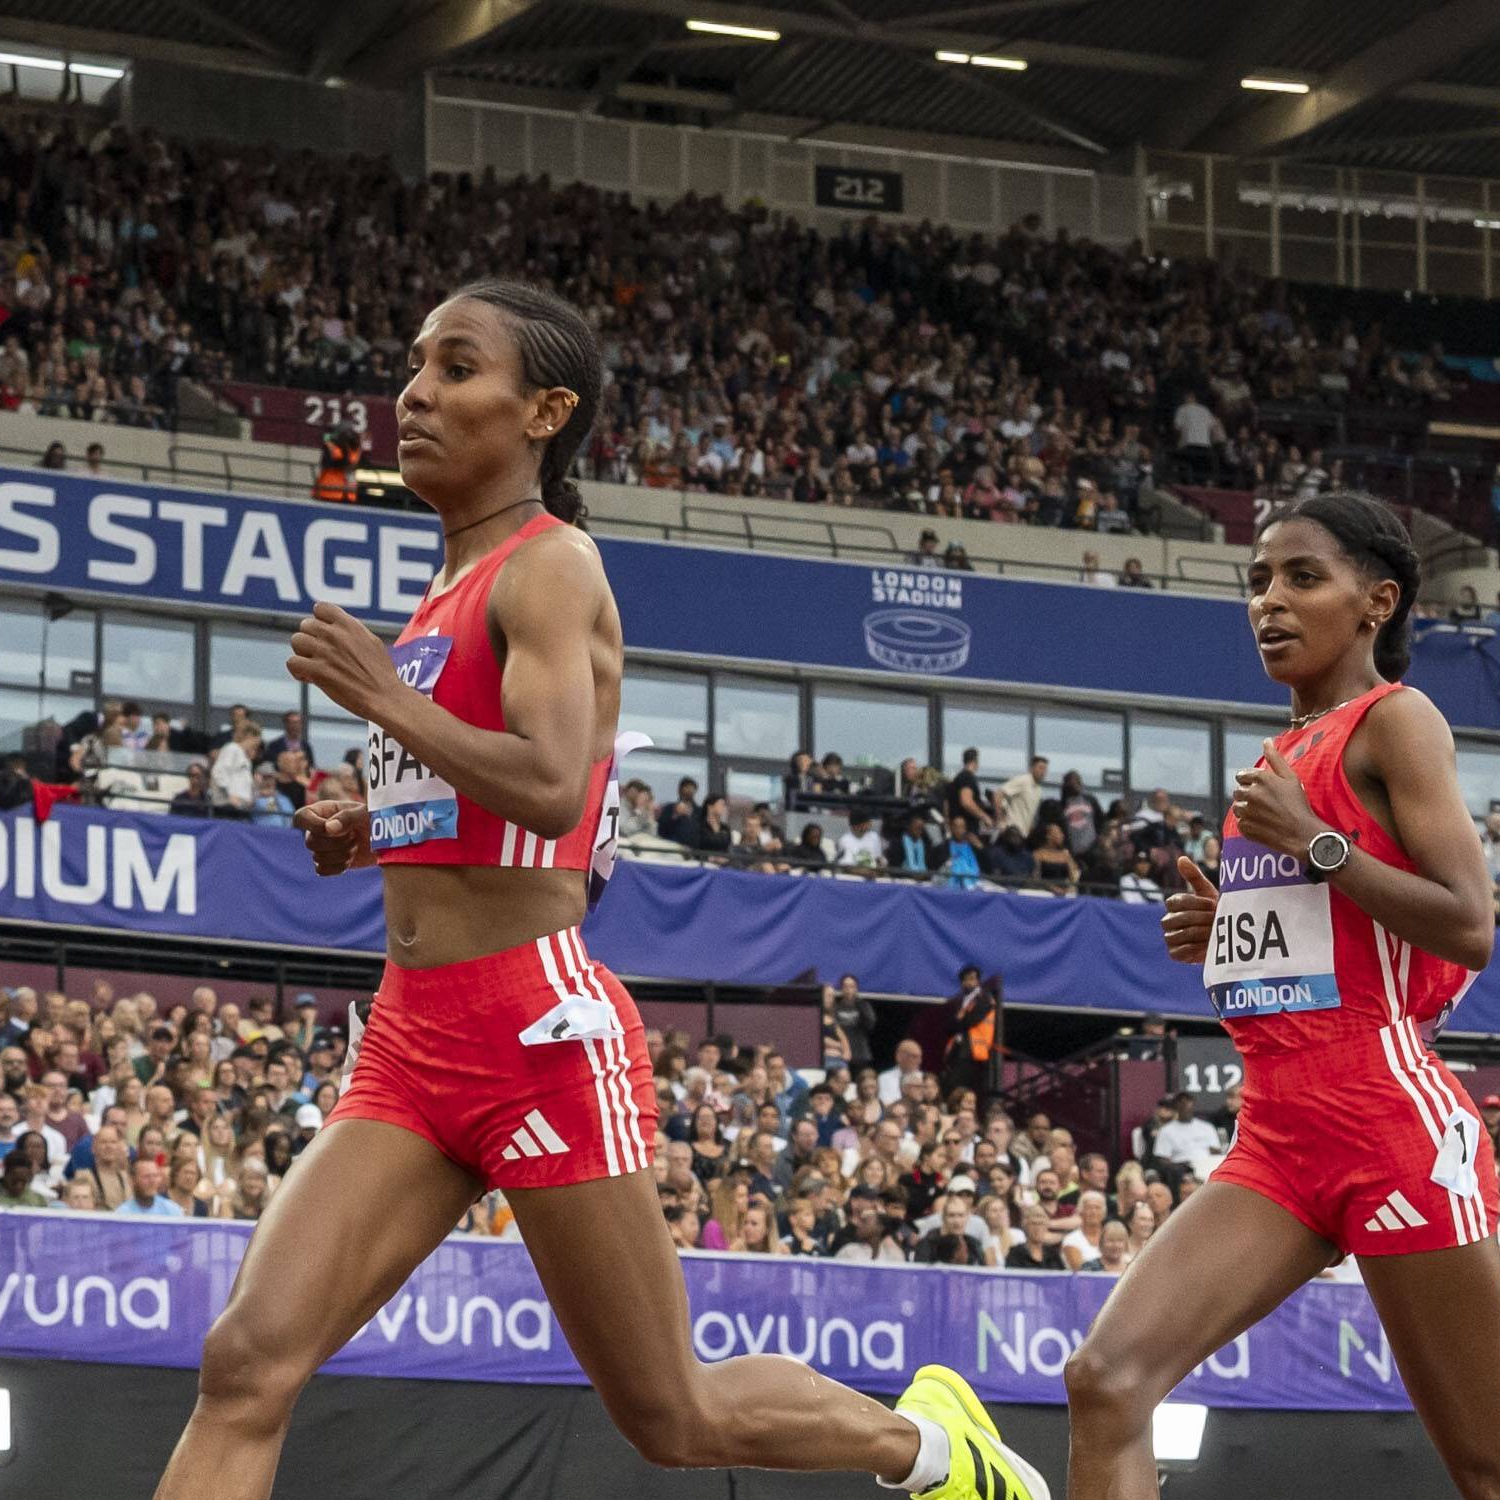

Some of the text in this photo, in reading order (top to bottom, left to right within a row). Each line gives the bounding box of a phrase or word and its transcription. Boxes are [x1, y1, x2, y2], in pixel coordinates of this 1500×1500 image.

[304, 396, 368, 433] 213
[85, 493, 438, 613] STAGE
[871, 570, 962, 592] LONDON
[871, 586, 962, 609] STADIUM
[1214, 909, 1290, 966] EISA
[1225, 983, 1313, 1010] LONDON
[1183, 1062, 1242, 1093] 112
[694, 1308, 904, 1371] ovuna
